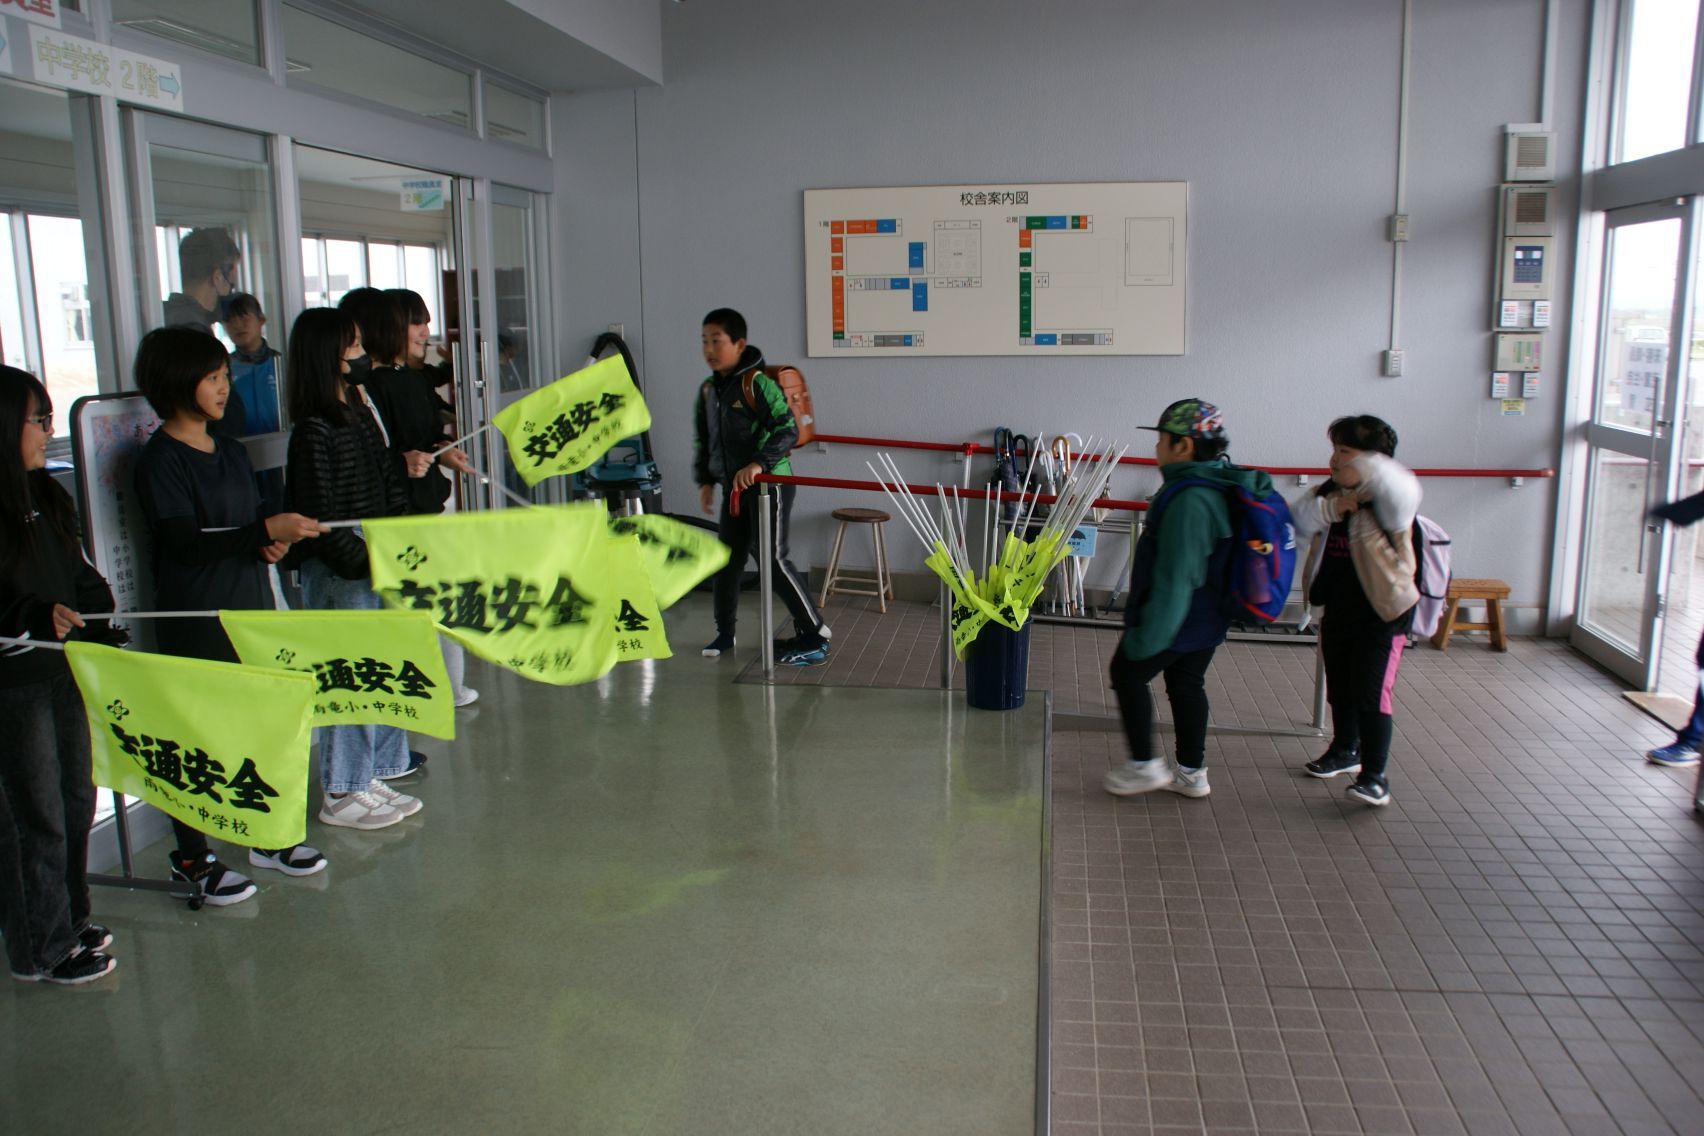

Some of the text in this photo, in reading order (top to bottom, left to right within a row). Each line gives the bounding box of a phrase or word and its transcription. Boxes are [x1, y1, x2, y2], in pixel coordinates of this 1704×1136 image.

[37, 36, 158, 99] 中学校 2階
[960, 191, 1029, 206] 校舎案内図
[522, 392, 627, 467] 交通安全
[284, 656, 437, 699] 通安全
